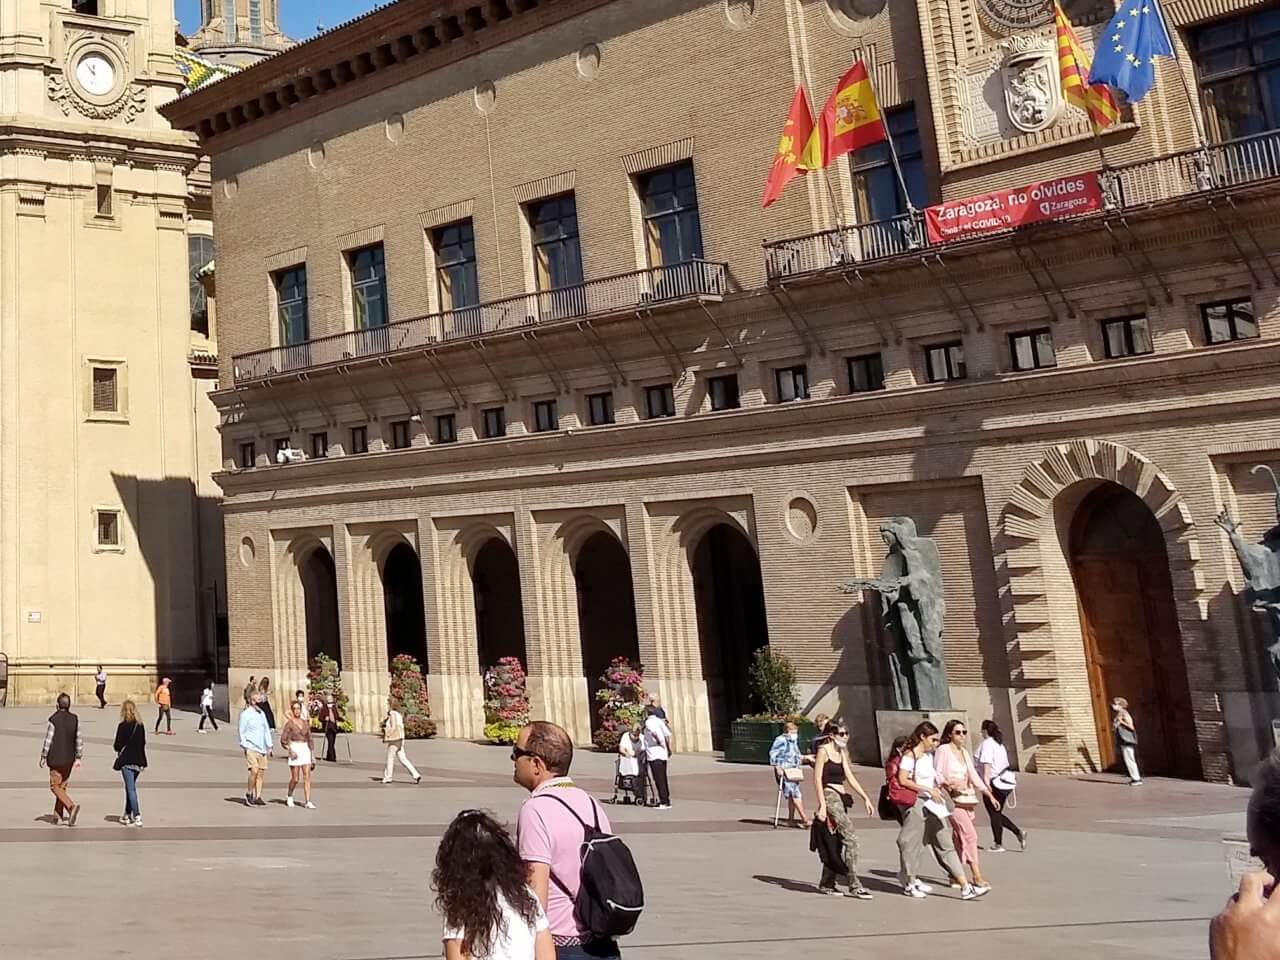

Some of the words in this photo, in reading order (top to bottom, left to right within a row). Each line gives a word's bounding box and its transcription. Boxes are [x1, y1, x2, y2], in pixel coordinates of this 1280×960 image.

[937, 198, 1005, 221] Zaragoza,
[1008, 192, 1028, 208] no
[1031, 179, 1085, 200] olvides
[1050, 197, 1088, 210] Zaragoza
